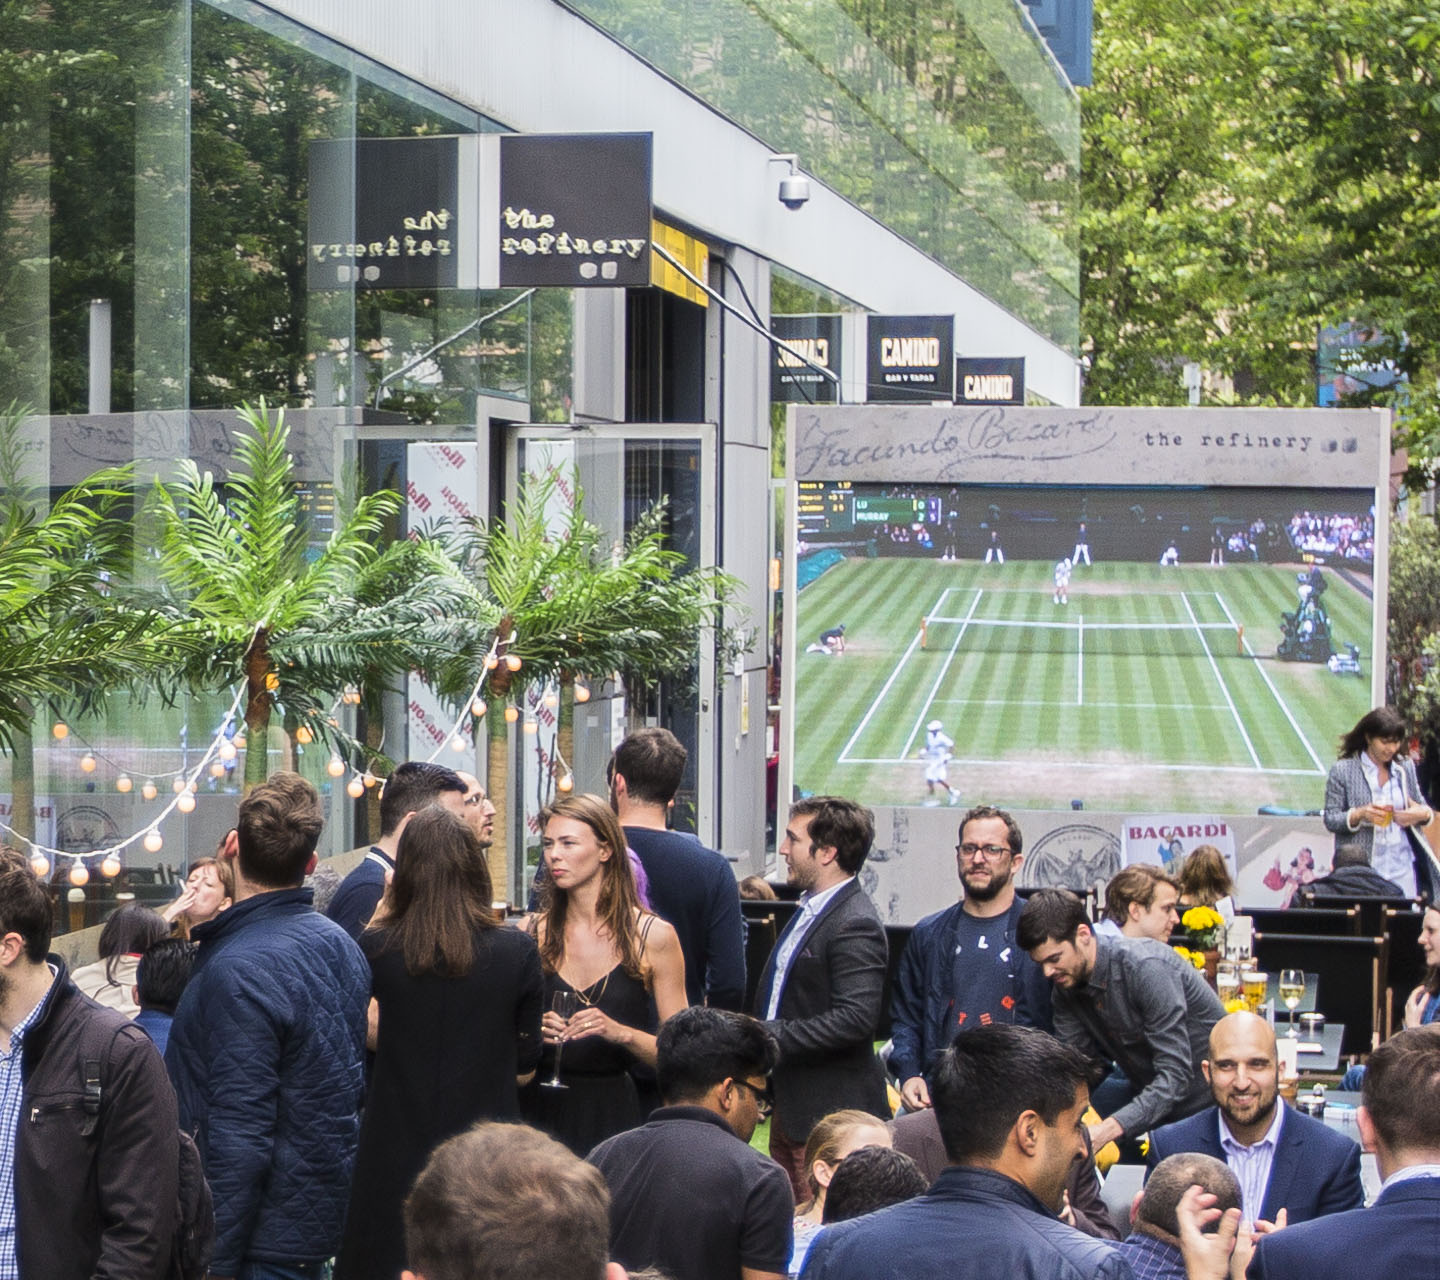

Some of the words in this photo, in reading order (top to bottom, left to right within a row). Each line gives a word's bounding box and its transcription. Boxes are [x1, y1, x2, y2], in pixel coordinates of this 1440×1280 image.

[502, 206, 556, 229] the
[502, 232, 647, 260] refinery
[881, 337, 940, 367] CAMINO
[964, 375, 1013, 400] CAMINO
[1144, 432, 1183, 447] the
[1200, 432, 1313, 452] refinery
[856, 512, 889, 521] MURRAY
[1128, 823, 1228, 840] BACARDI
